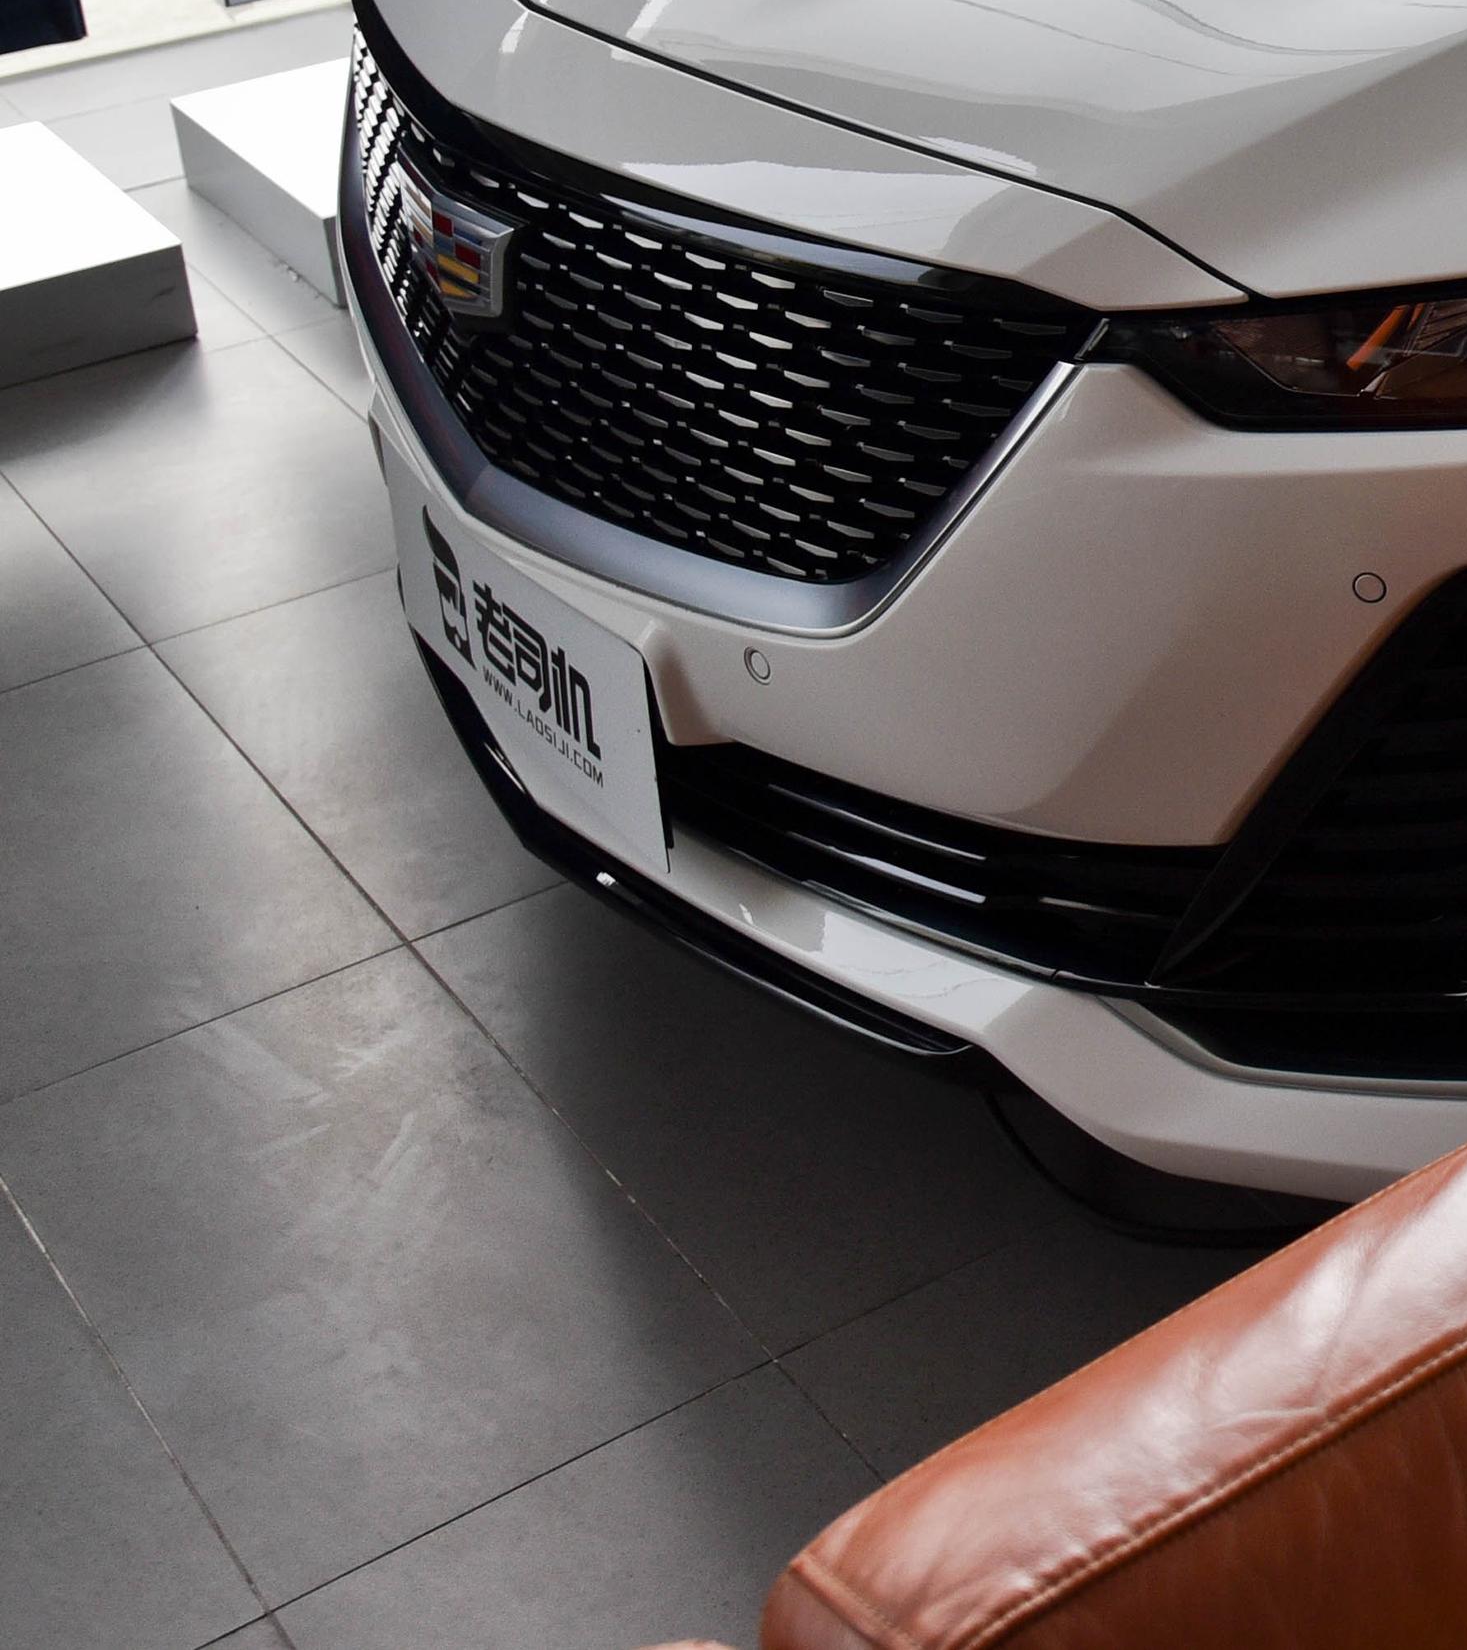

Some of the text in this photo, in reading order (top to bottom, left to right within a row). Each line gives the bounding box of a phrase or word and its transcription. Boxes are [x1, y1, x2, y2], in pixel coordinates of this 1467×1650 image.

[473, 582, 602, 761] 老司机
[482, 668, 604, 788] WWW.LAOSIJI.COM
